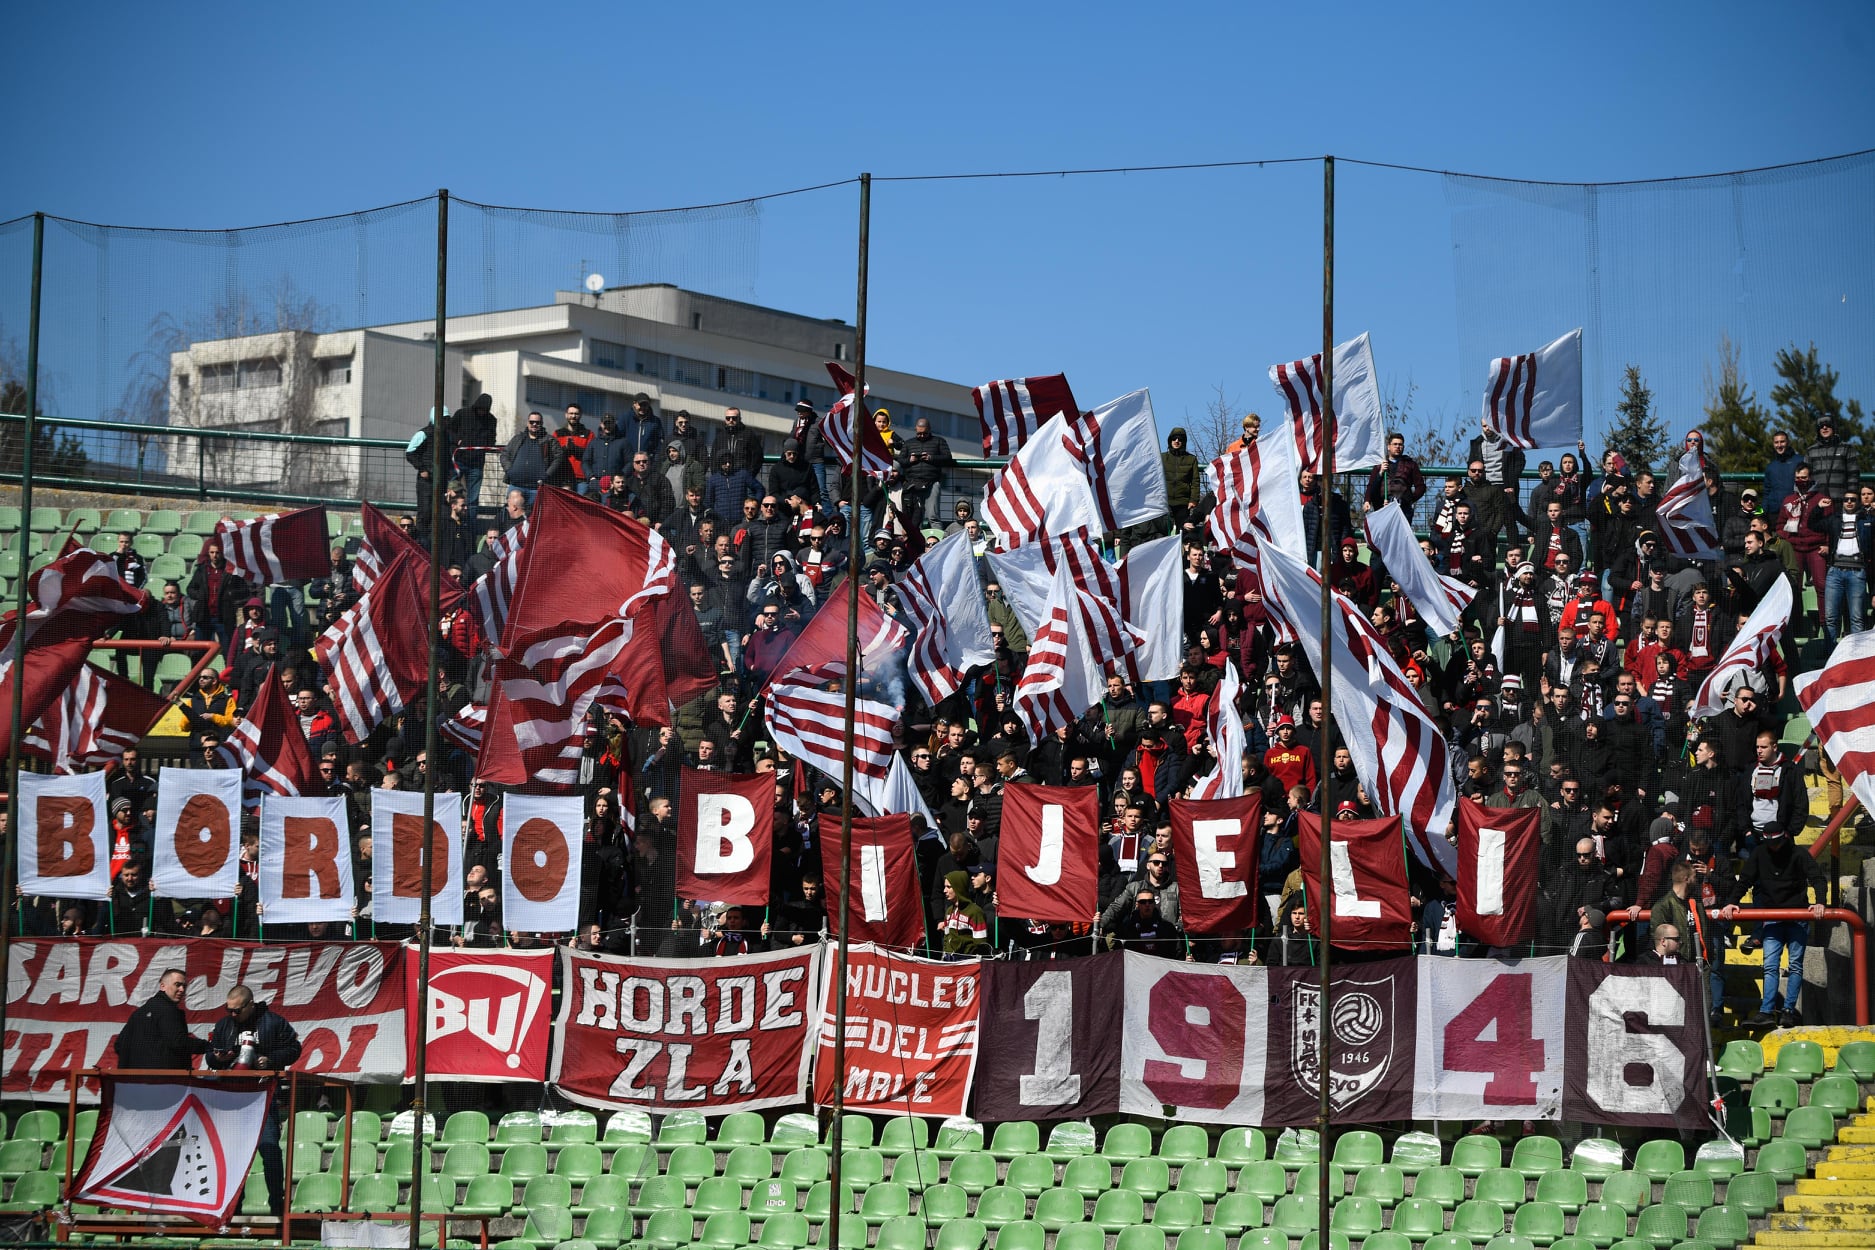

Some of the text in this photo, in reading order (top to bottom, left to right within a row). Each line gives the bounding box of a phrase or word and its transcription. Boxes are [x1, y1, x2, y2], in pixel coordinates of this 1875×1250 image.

[36, 792, 1506, 923] BORDO BIJELI
[575, 966, 806, 1035] HORDE
[846, 963, 976, 1009] NUCLEO
[1299, 993, 1320, 1007] FK
[868, 1018, 933, 1061] DEL
[1341, 1052, 1370, 1064] 1946
[608, 1037, 757, 1101] ZLA
[843, 1065, 936, 1104] MALE
